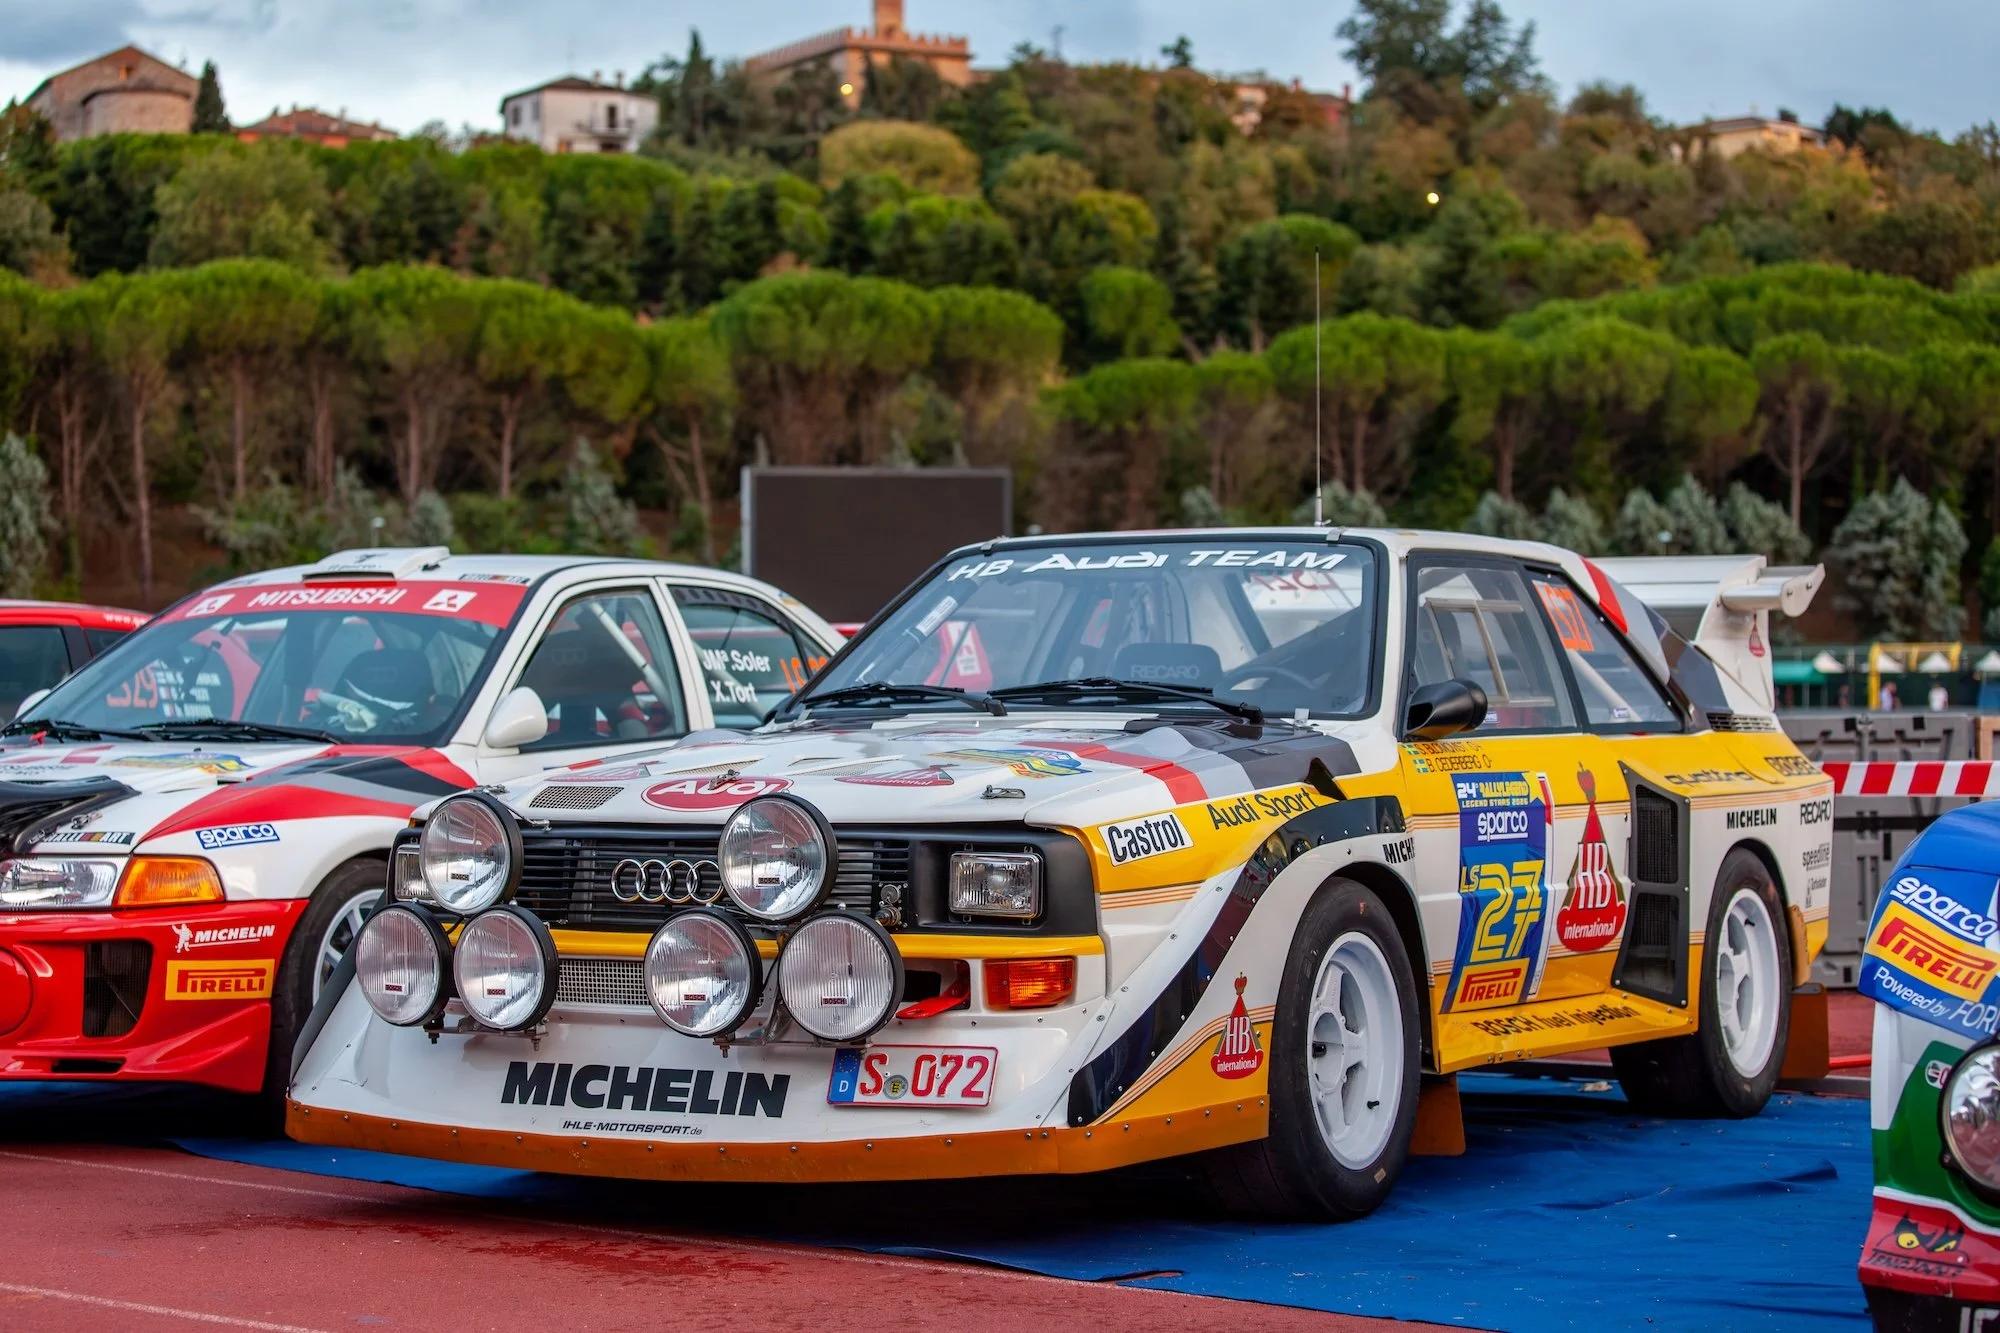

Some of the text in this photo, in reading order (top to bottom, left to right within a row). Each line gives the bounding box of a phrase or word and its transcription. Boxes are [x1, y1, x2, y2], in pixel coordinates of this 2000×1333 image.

[947, 549, 1347, 582] HB Audi TEAM
[246, 587, 408, 608] MITSUBISHI
[1129, 663, 1200, 680] RECARO
[651, 778, 780, 796] Audi
[1664, 768, 1755, 787] quattro
[1206, 787, 1319, 831] Audi Sport
[1461, 799, 1489, 808] LEGEND
[1489, 798, 1511, 807] STARS
[1800, 799, 1832, 825] RECARO
[1478, 810, 1528, 843] sparco
[1726, 807, 1778, 830] MICHELIN
[100, 831, 131, 844] ART
[200, 823, 275, 848] sparco
[1106, 814, 1186, 863] Castrol
[1460, 864, 1481, 893] LS
[1577, 842, 1613, 911] HB
[1469, 859, 1545, 963] 27
[1895, 876, 1998, 938] sparco
[194, 923, 275, 944] MICHELIN
[1563, 916, 1617, 940] international
[1876, 916, 1997, 990] PIRELLI
[176, 966, 267, 993] PIRELLI
[1459, 967, 1522, 1004] PIRELLI
[1874, 965, 1936, 1010] Powered
[1930, 1000, 1950, 1018] by
[823, 997, 846, 1005] BOSCH
[1471, 1003, 1642, 1037] BOSCH fuel injection
[1224, 1015, 1252, 1056] HB
[859, 1052, 990, 1098] S 072
[1216, 1055, 1258, 1073] international
[500, 1060, 791, 1119] MICHELIN
[838, 1079, 849, 1093] D
